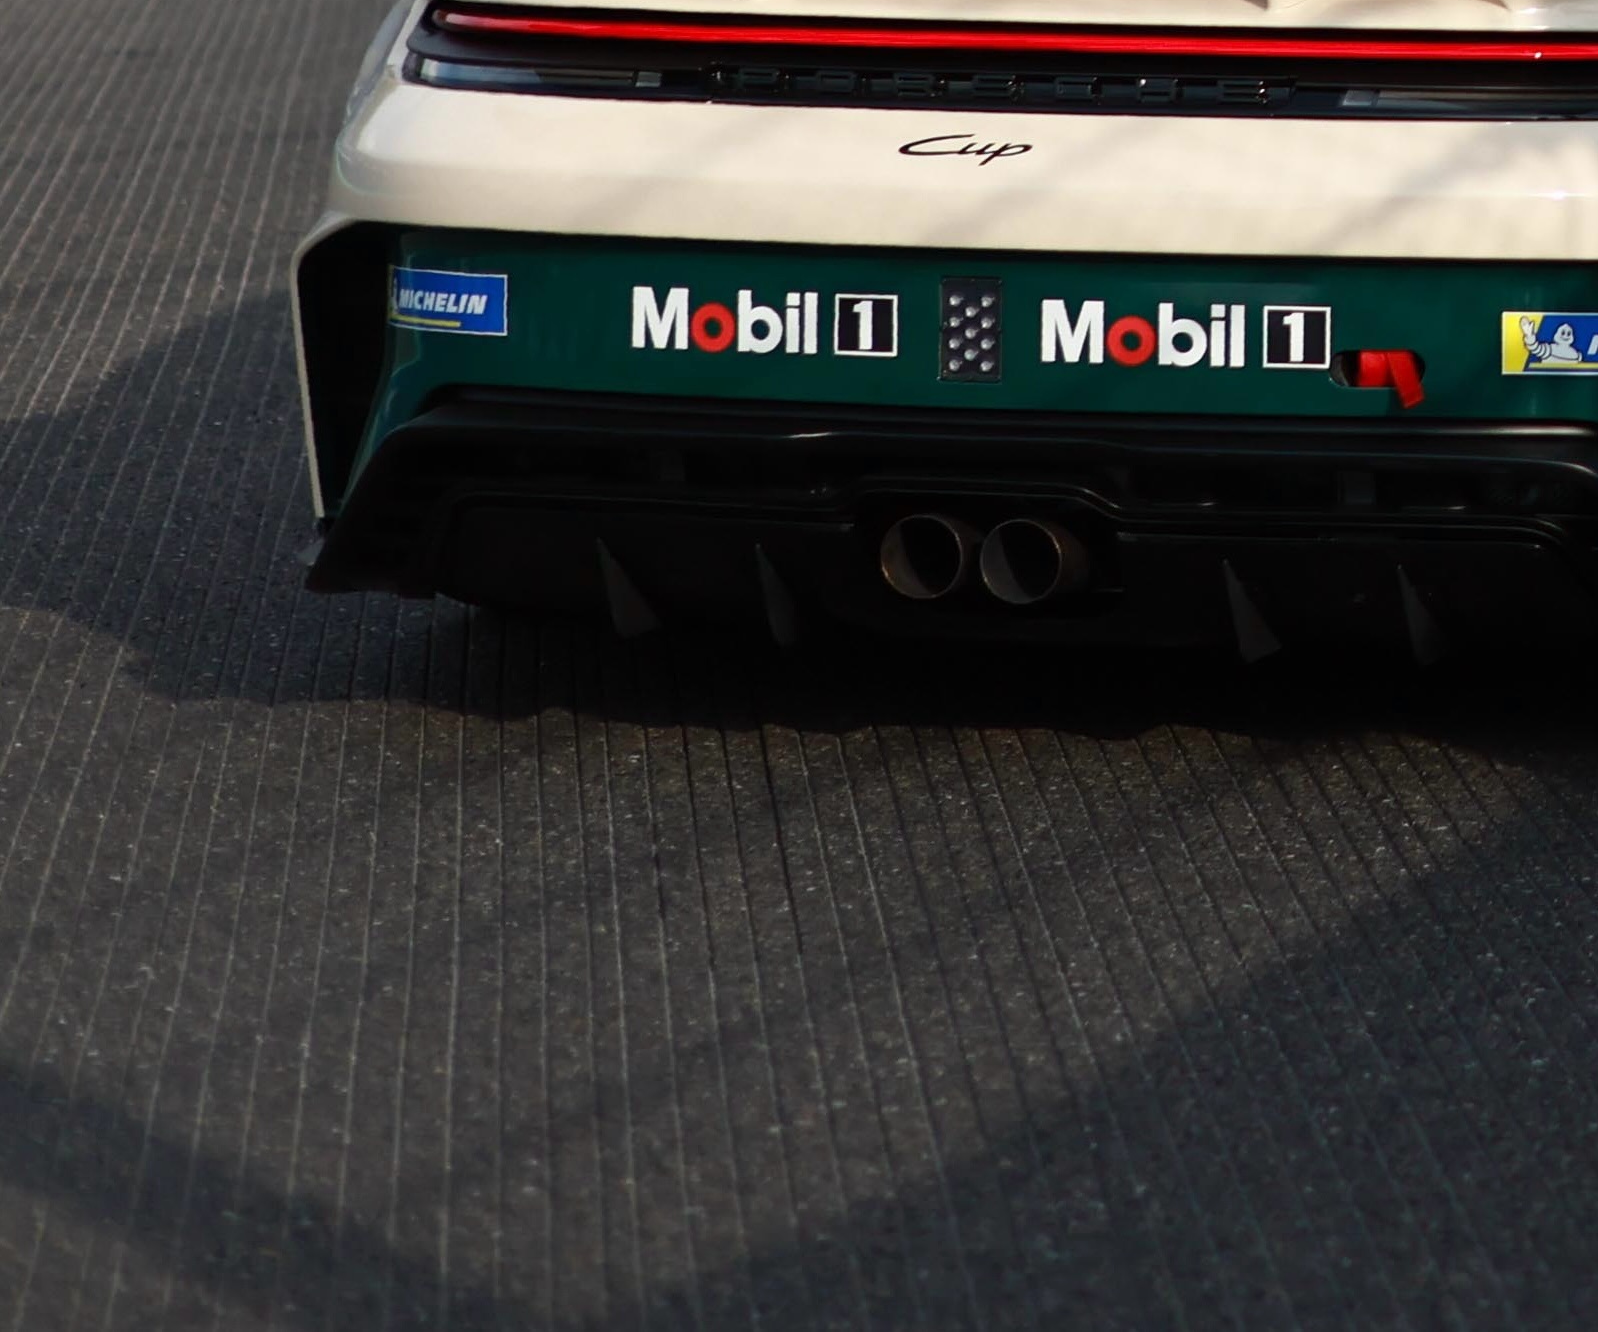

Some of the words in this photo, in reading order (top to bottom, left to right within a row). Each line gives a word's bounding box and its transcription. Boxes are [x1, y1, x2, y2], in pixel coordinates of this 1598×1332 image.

[898, 133, 1033, 167] Cup
[398, 288, 488, 315] MICHELIN
[631, 285, 819, 355] Mobil
[1040, 289, 1246, 367] Mobil
